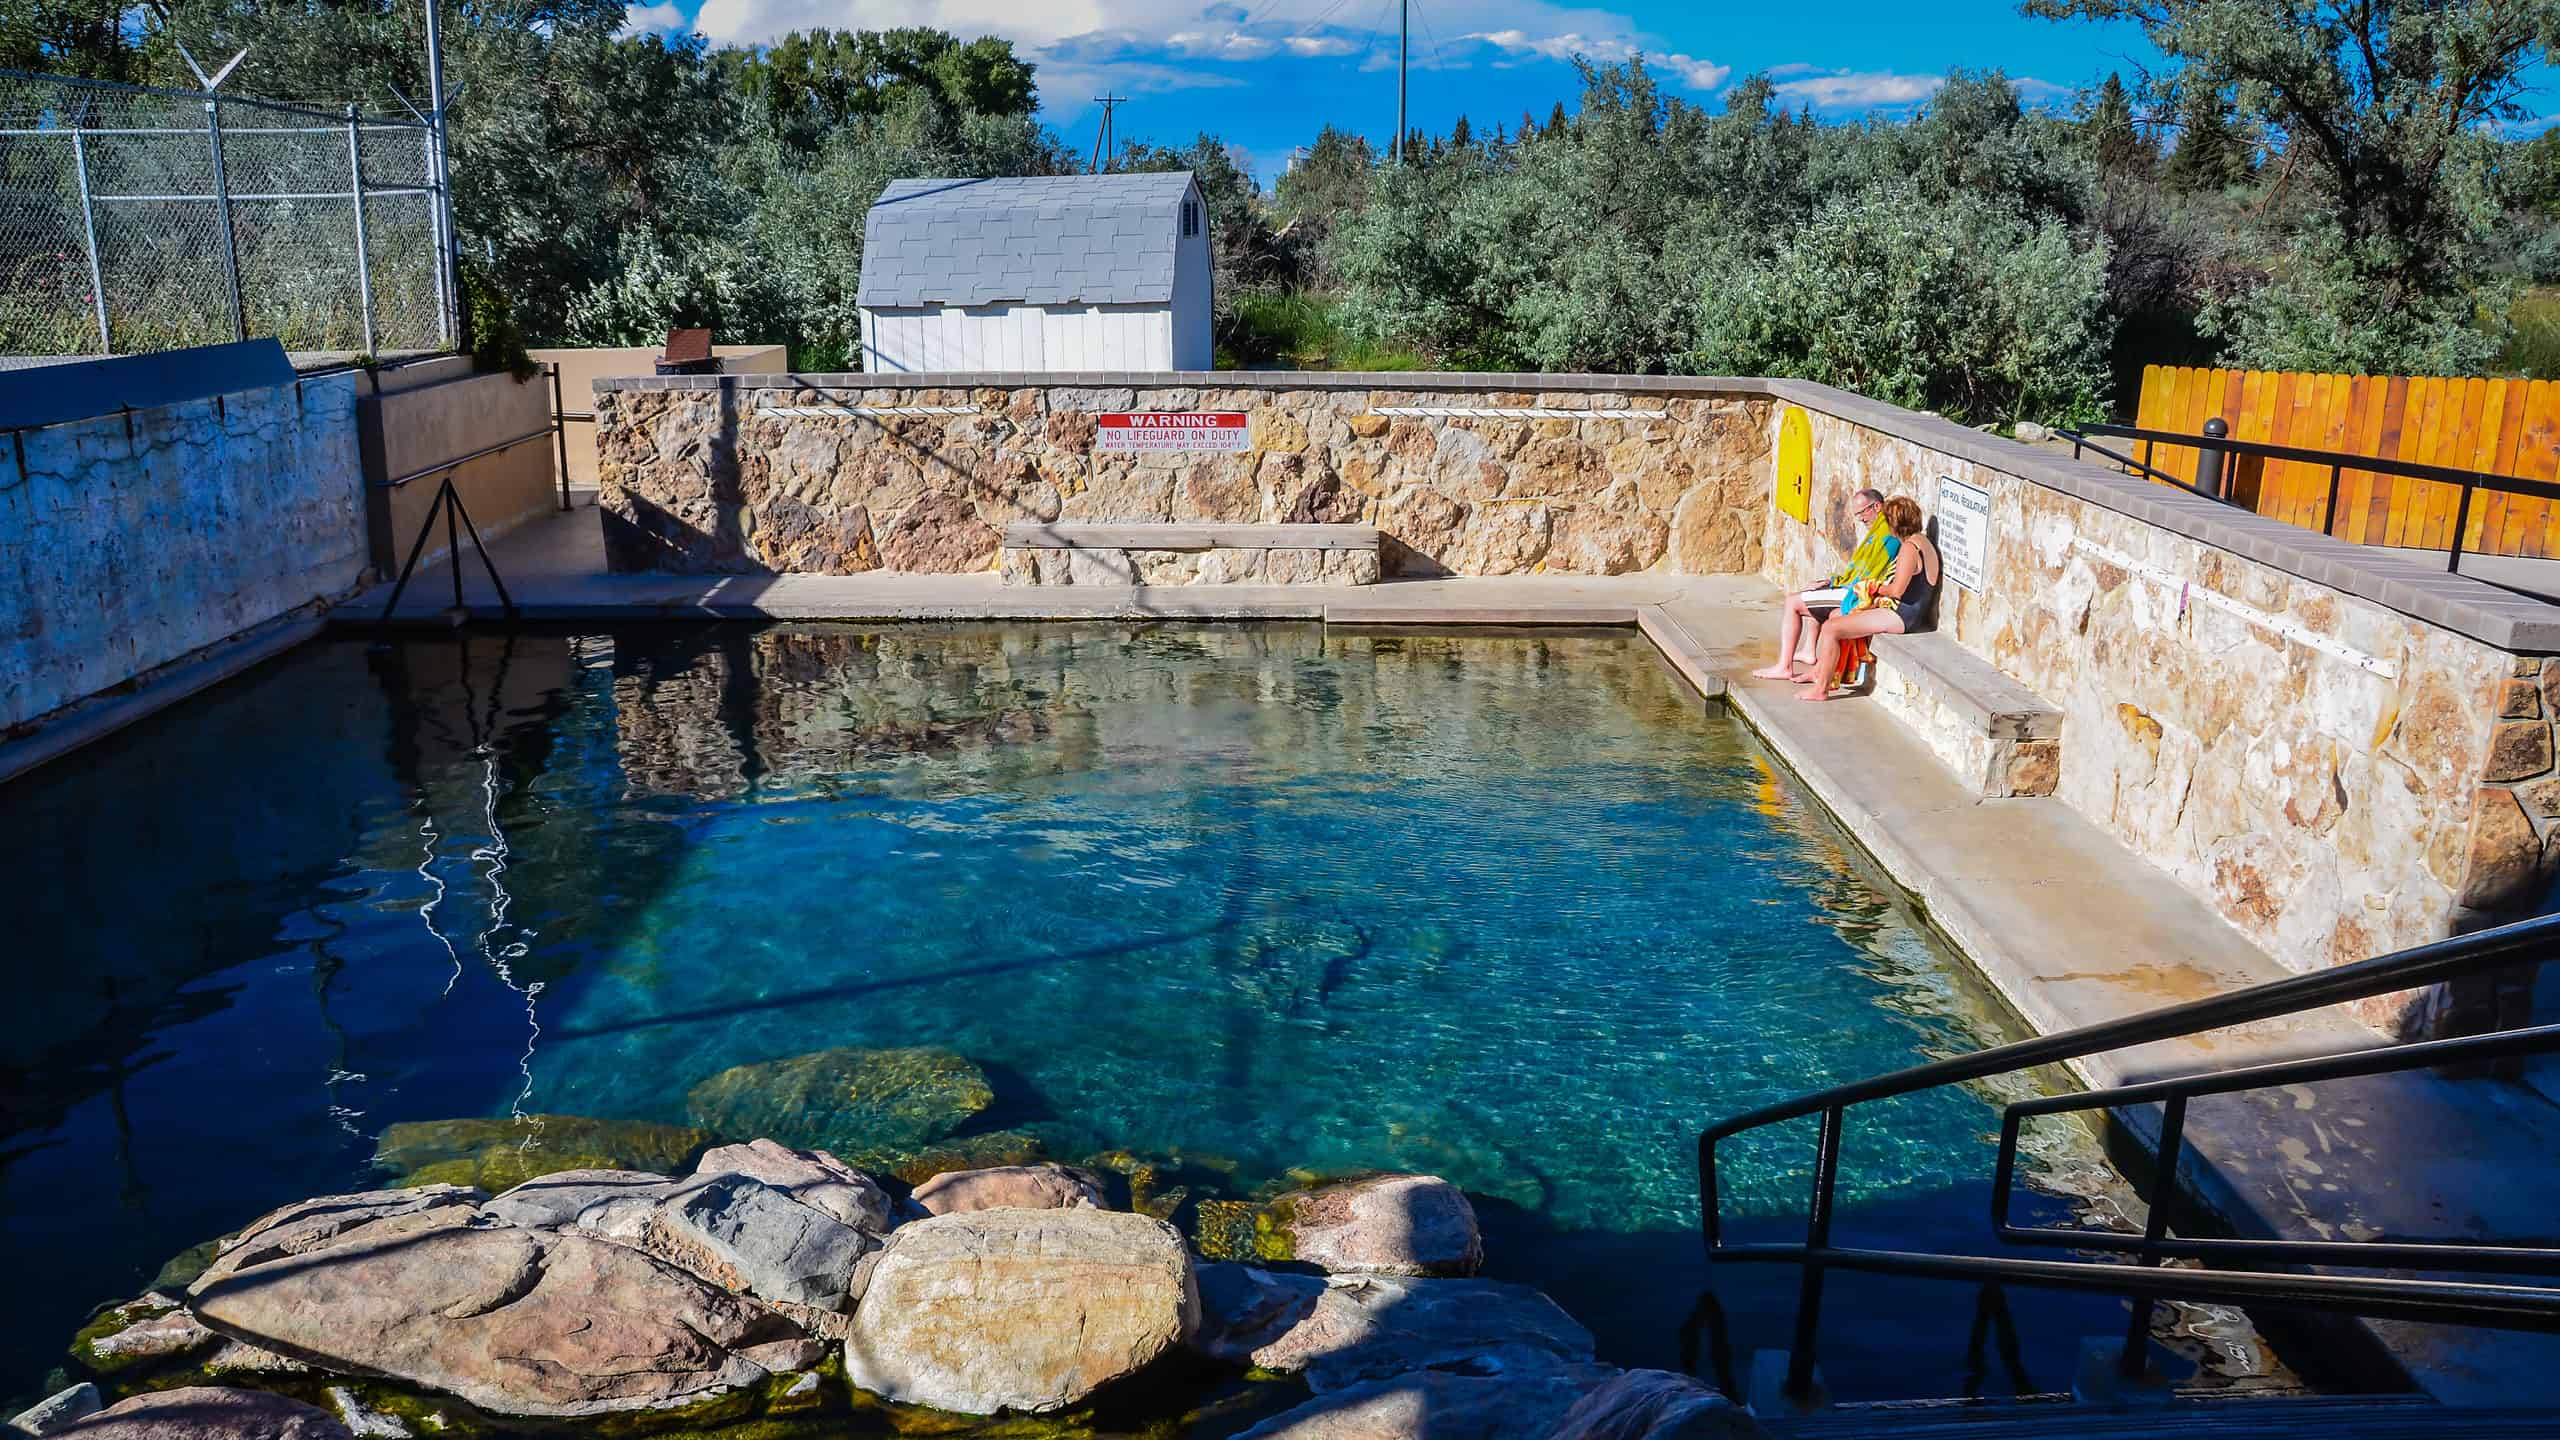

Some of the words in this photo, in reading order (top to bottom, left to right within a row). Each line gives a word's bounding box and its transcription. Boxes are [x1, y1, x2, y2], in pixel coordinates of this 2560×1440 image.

[1130, 415, 1217, 427] WARNING
[1106, 430, 1121, 441] NO
[1127, 430, 1185, 441] LIFEGUARD
[1191, 430, 1205, 441] ON
[1211, 430, 1240, 441] DUTY
[1950, 491, 1960, 505] POOL
